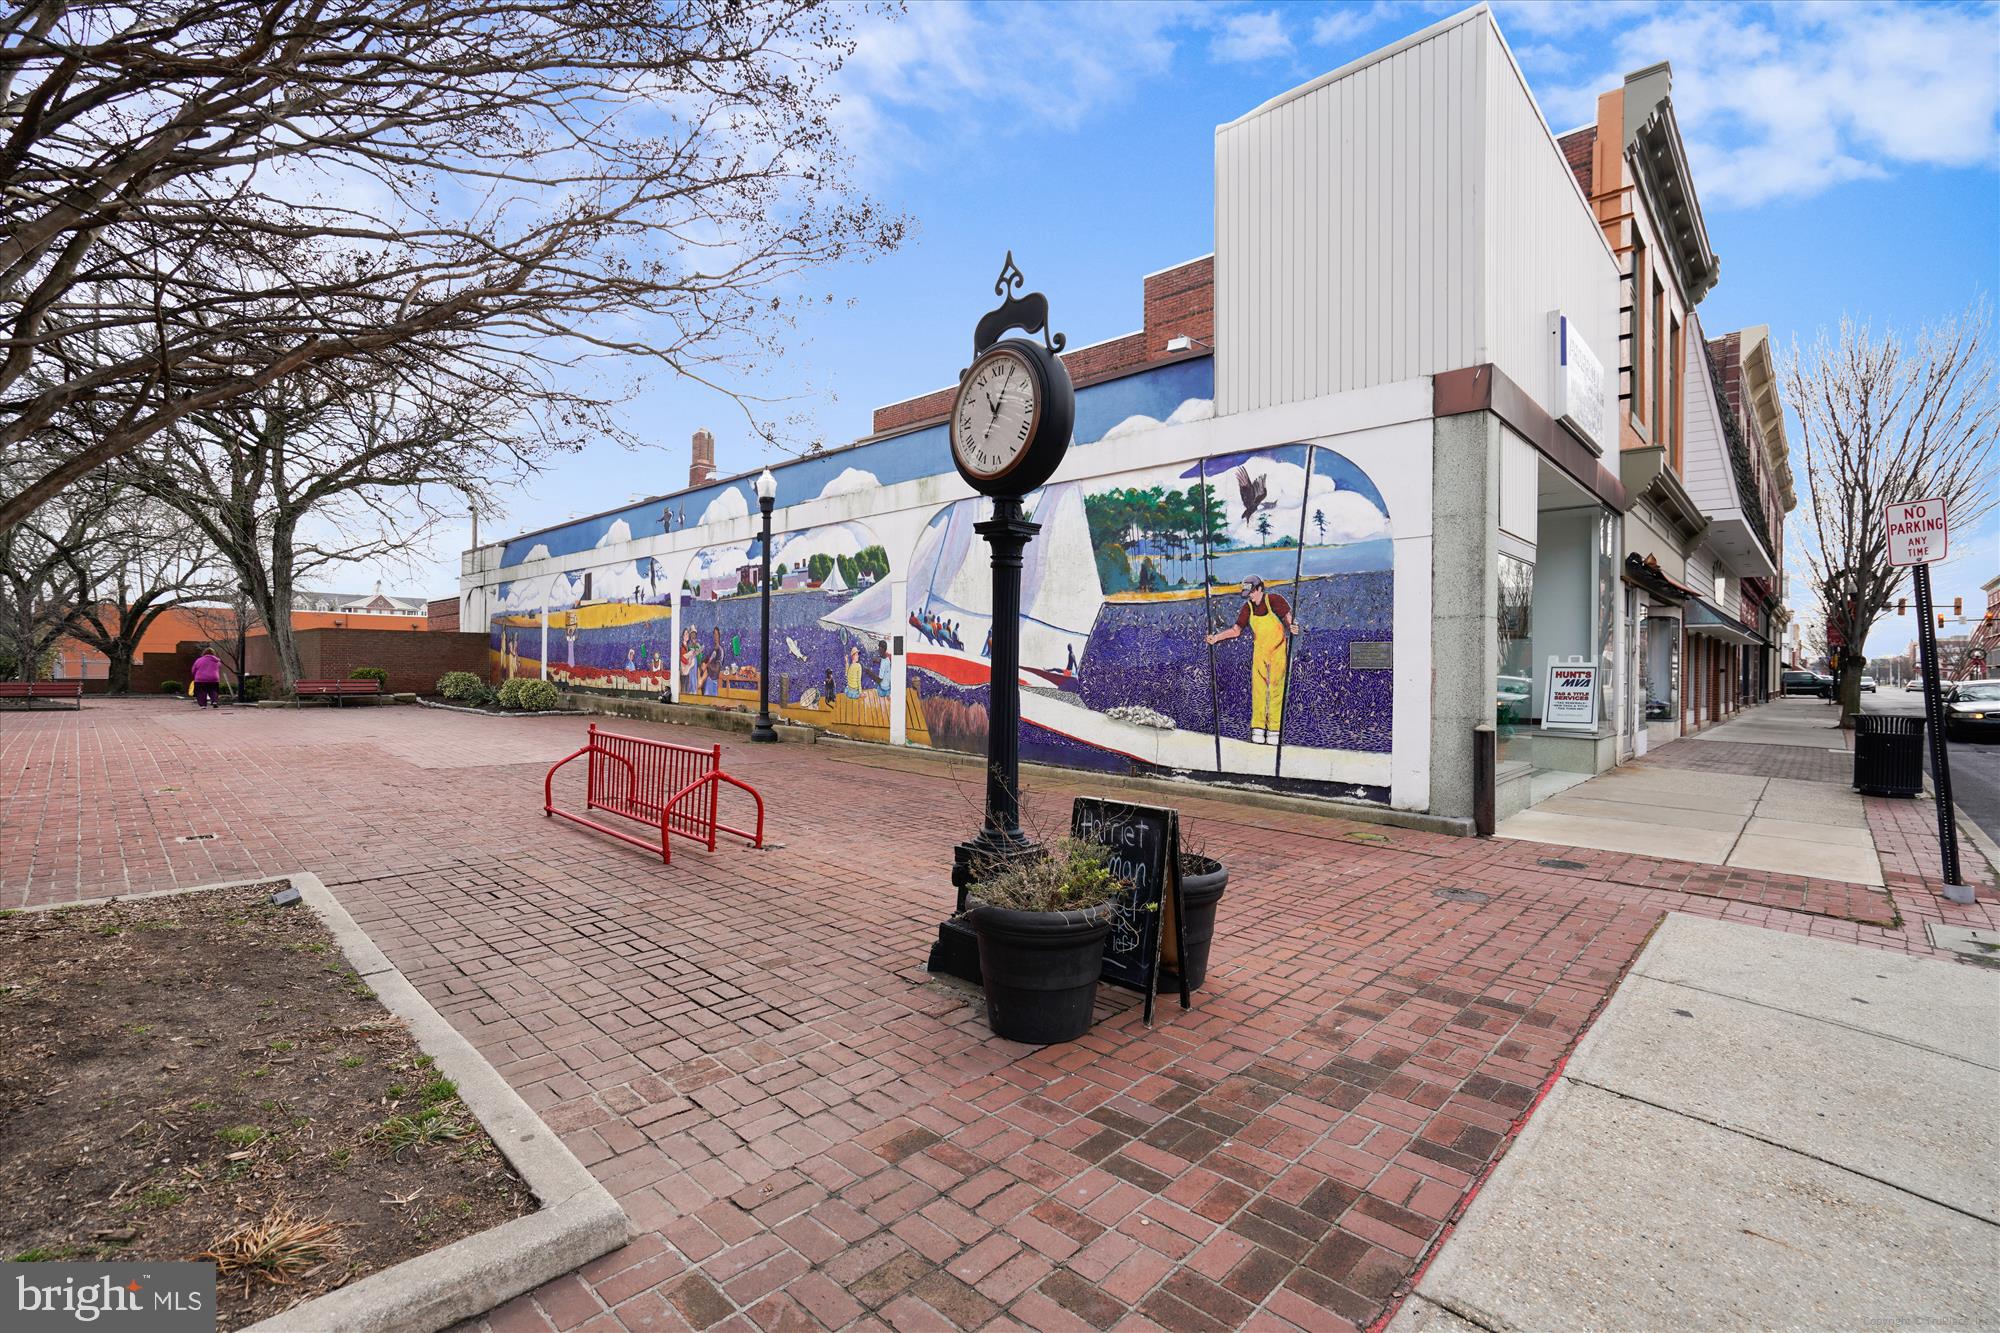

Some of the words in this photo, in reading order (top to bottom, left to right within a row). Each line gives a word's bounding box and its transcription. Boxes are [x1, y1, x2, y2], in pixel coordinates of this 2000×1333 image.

[1904, 506, 1926, 520] NO
[1890, 517, 1943, 536] PARKING
[1908, 536, 1927, 546] ANY
[1908, 546, 1929, 557] TIME
[1561, 679, 1591, 687] MVA
[1080, 808, 1149, 848] Harriet
